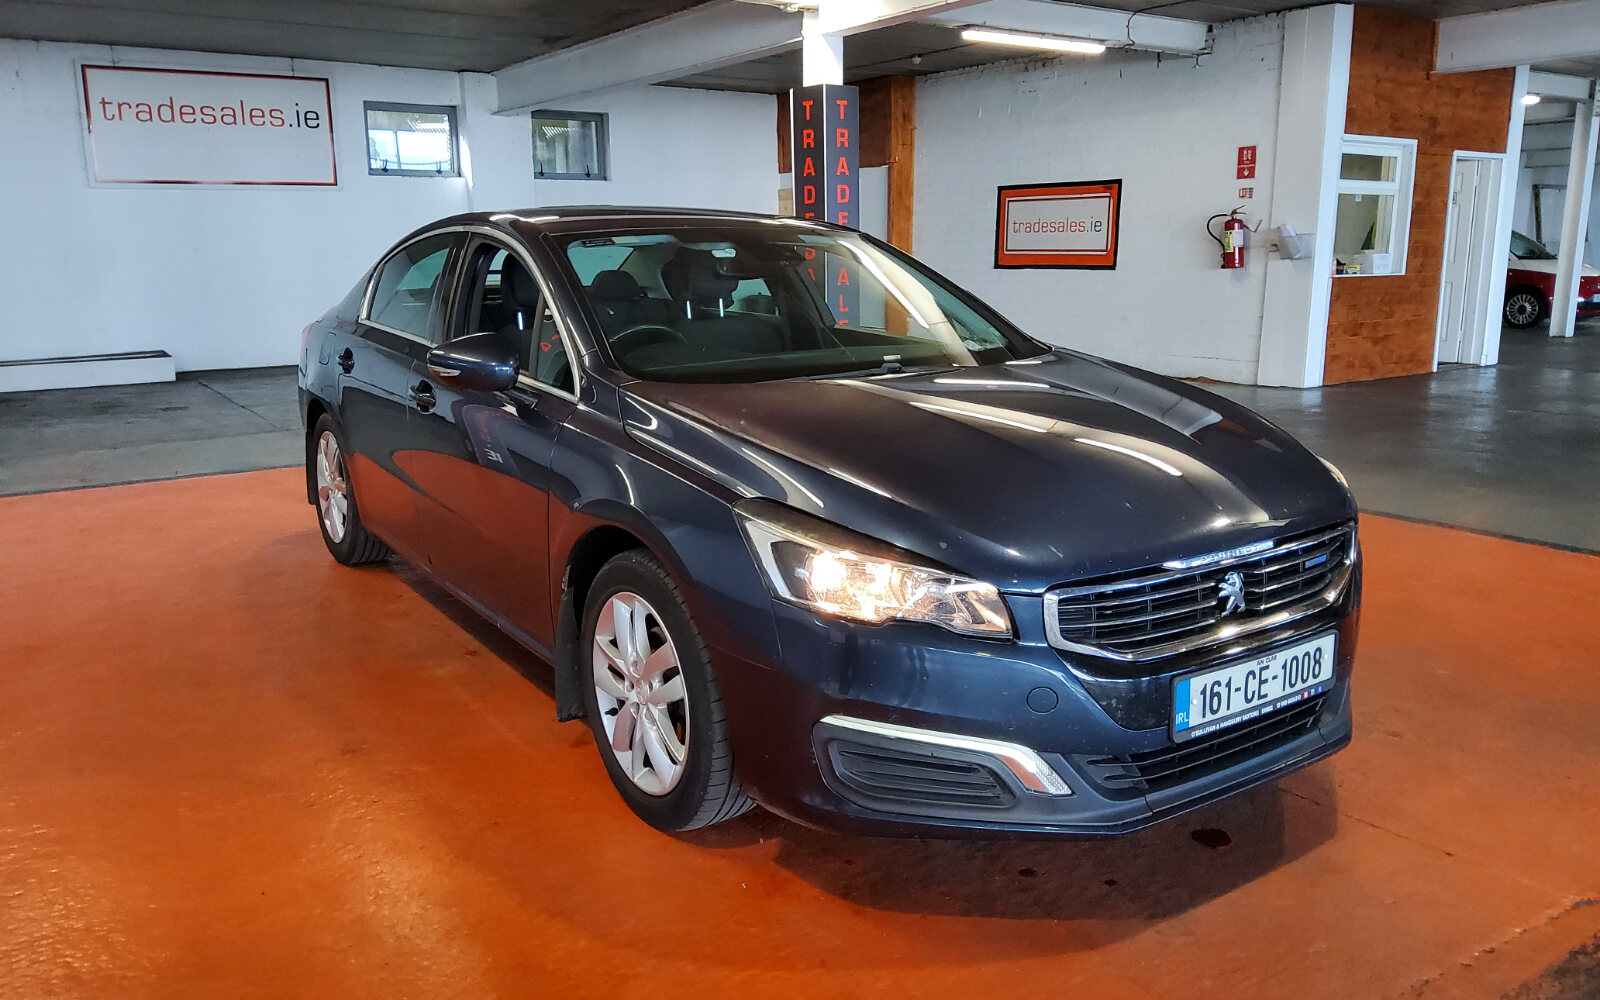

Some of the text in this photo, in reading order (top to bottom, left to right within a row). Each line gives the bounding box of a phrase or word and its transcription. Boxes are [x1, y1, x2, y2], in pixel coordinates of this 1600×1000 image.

[99, 97, 320, 129] tradesales.ie
[836, 100, 849, 225] TRADE
[1012, 216, 1102, 233] tradesales.ie
[1200, 646, 1322, 719] 161-CE-1008
[1175, 711, 1189, 725] IRL
